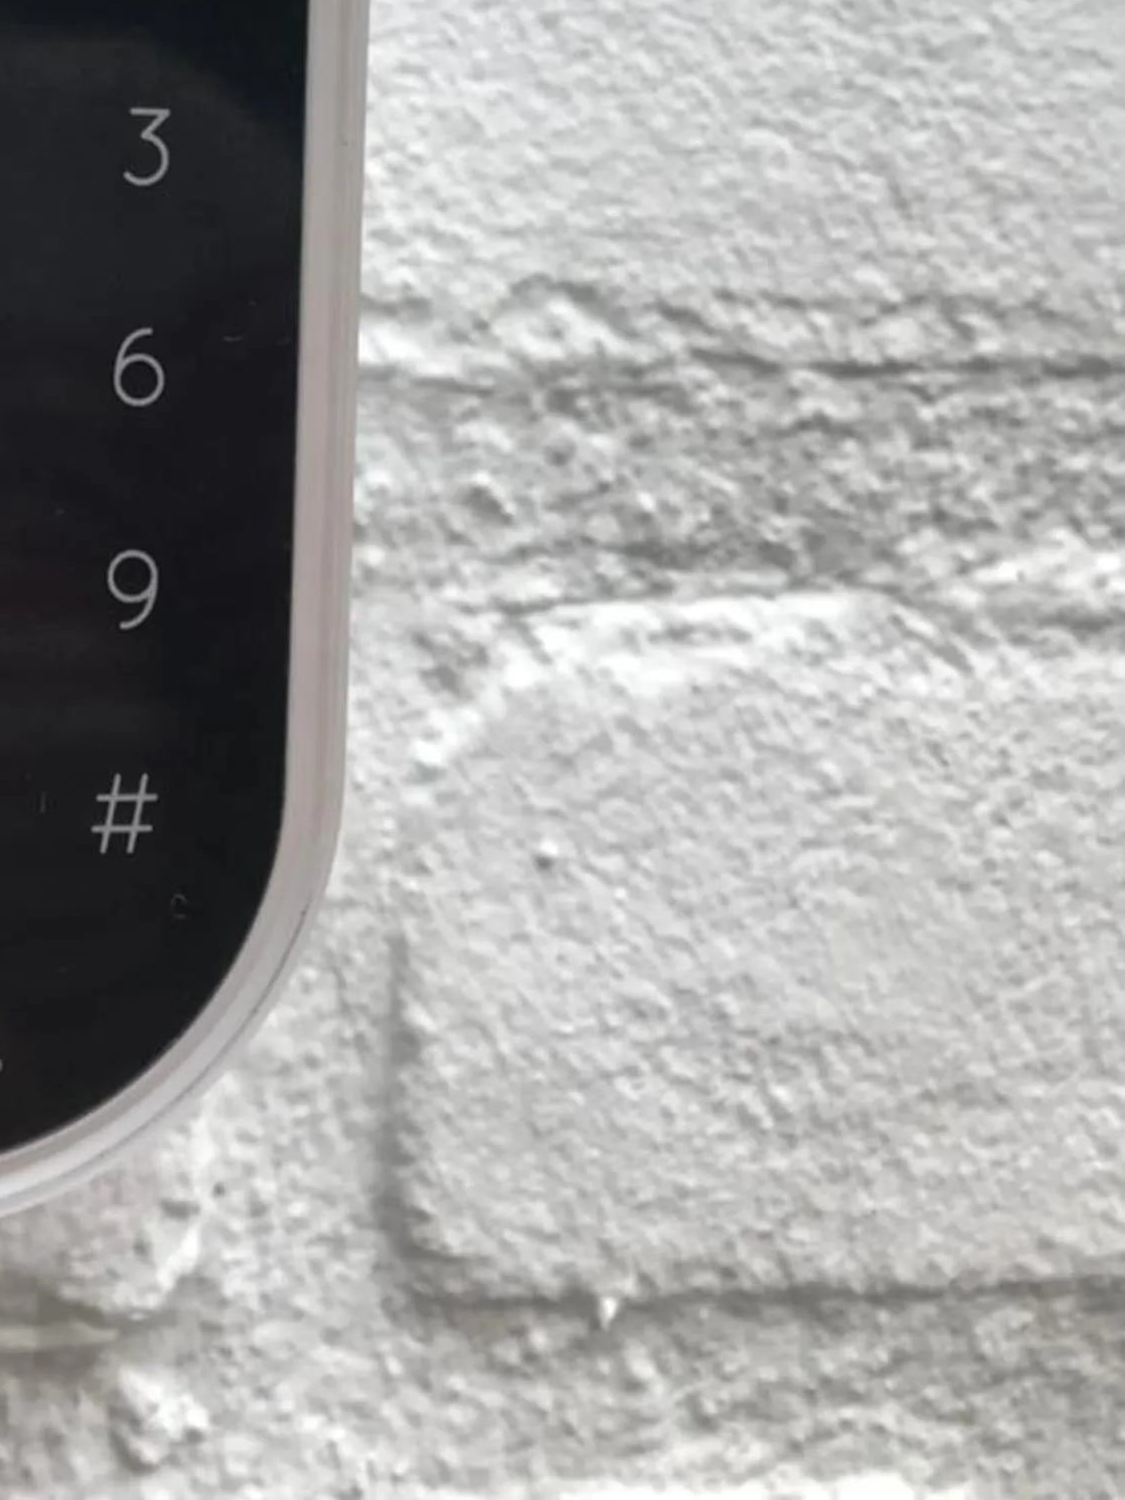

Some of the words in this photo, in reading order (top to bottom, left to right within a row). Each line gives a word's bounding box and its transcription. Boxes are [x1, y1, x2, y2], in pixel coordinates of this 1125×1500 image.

[123, 107, 171, 186] 3
[114, 327, 165, 407] 6
[107, 549, 159, 630] 9
[91, 773, 159, 854] #
